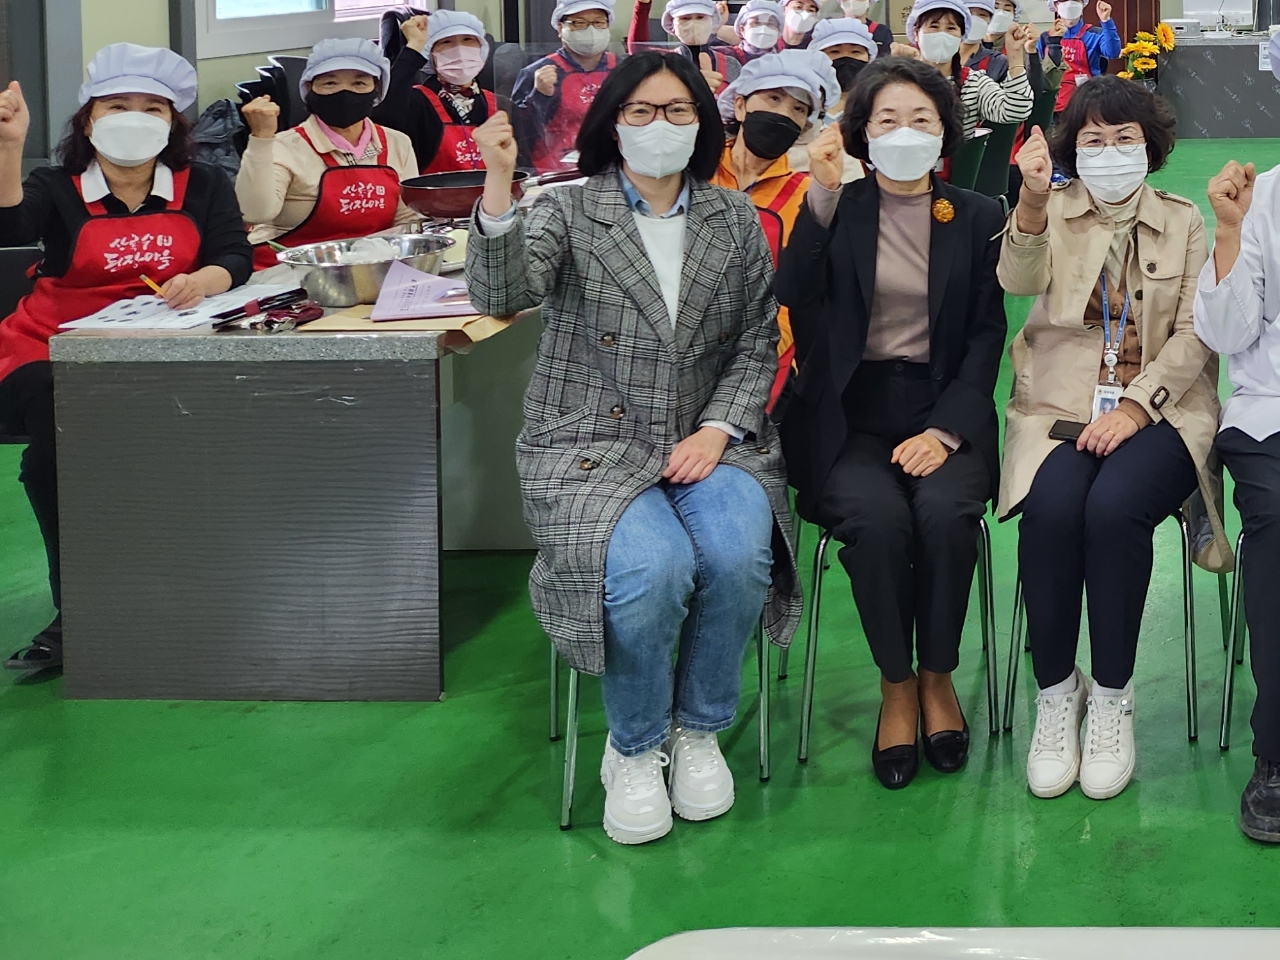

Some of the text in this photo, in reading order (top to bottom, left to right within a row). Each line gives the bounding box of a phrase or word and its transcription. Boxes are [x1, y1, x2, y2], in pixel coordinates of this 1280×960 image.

[339, 198, 386, 214] 된장마을
[109, 233, 154, 251] 상록수
[103, 249, 174, 272] 된장마을
